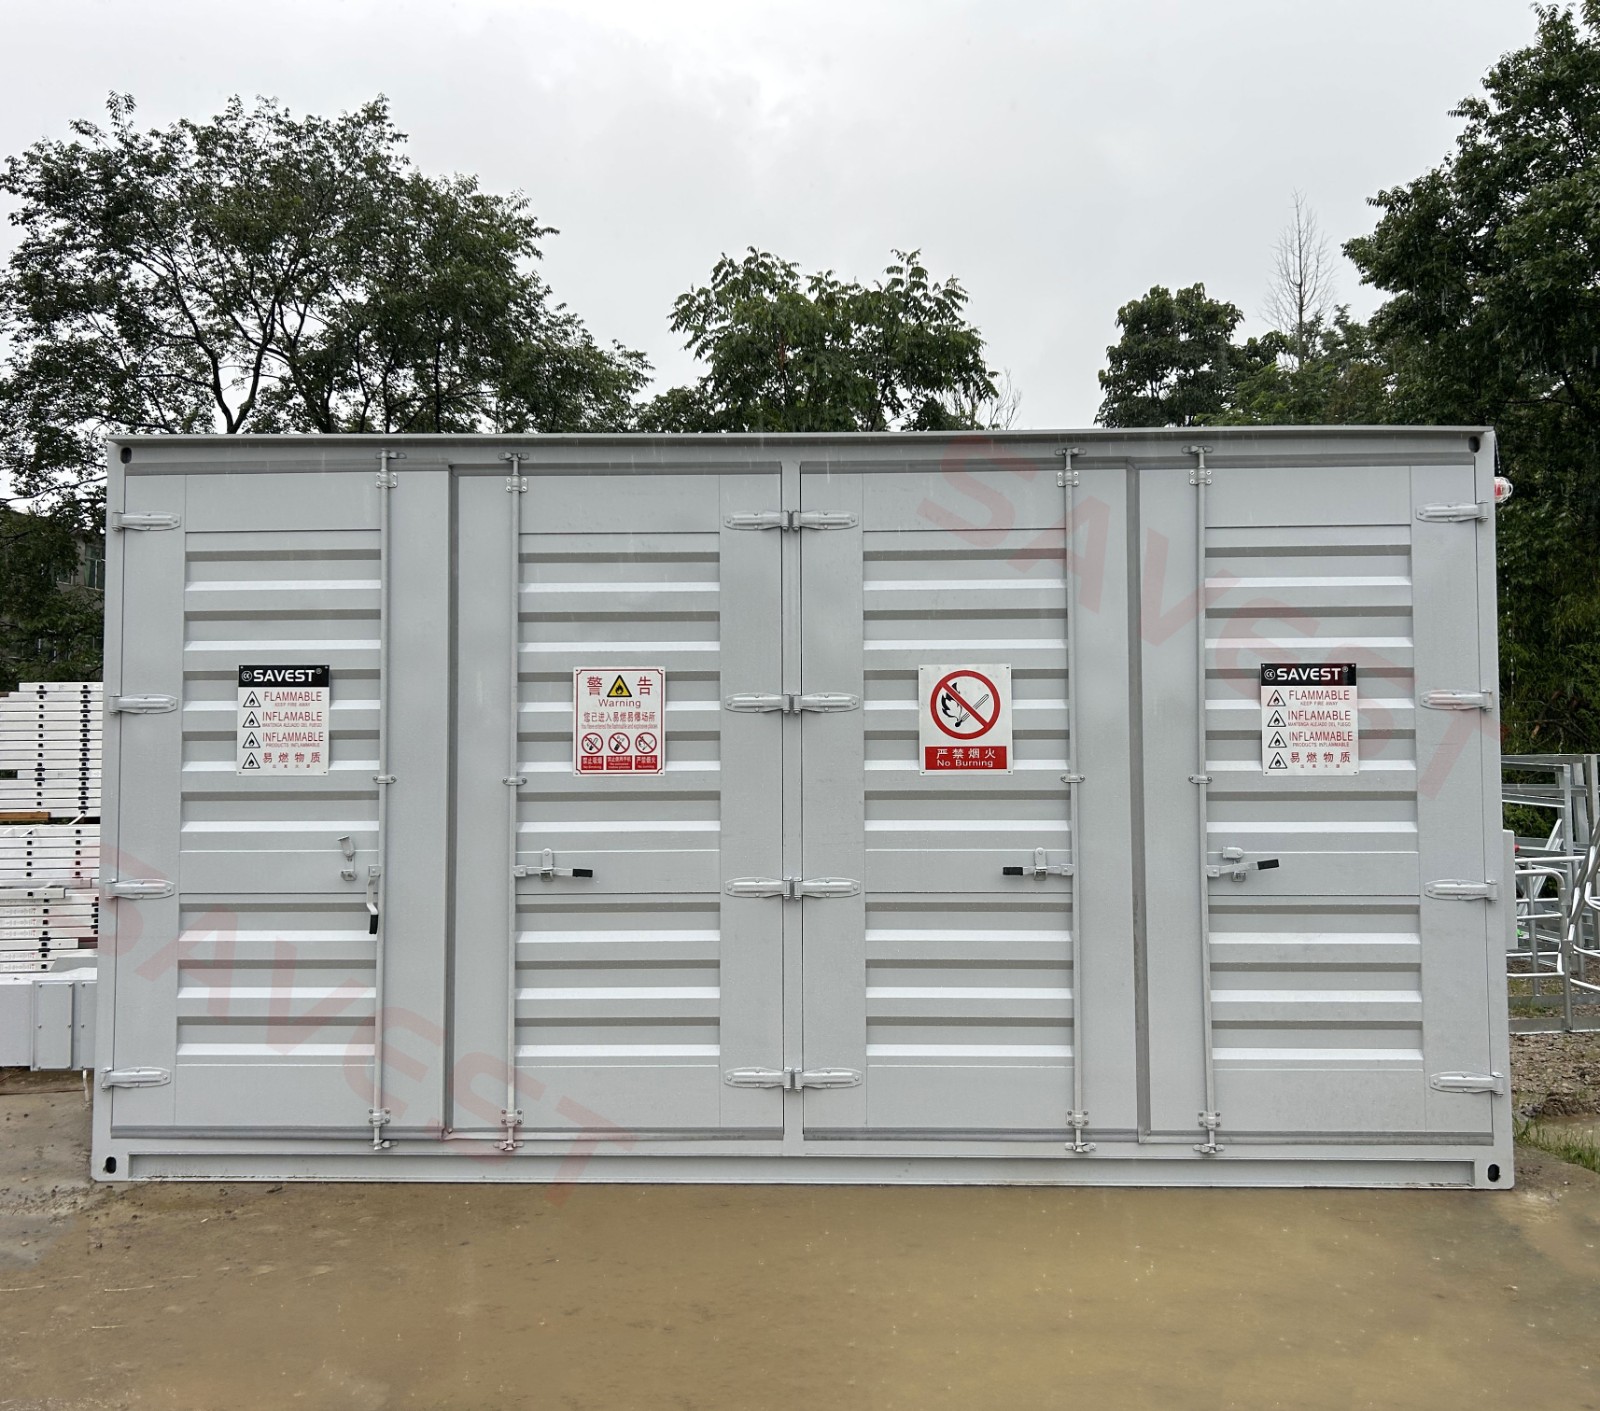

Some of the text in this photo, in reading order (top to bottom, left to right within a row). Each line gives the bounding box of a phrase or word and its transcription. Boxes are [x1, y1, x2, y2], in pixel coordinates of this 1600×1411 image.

[253, 669, 315, 682] SAVEST
[1276, 667, 1342, 681] SAVEST
[264, 691, 323, 702] FLAMMABLE
[1288, 690, 1350, 701] FLAMMABLE
[598, 699, 642, 709] Warning
[262, 711, 323, 722] INFLAMABLE
[1287, 710, 1351, 721] INFLAMABLE
[262, 731, 324, 742] INFLAMMABLE
[1289, 731, 1354, 742] INFLAMMABLE
[262, 751, 321, 764] 易燃物质
[936, 747, 996, 759] 严禁烟火
[1290, 751, 1351, 763] 易燃物质
[937, 759, 994, 768] No Burning
